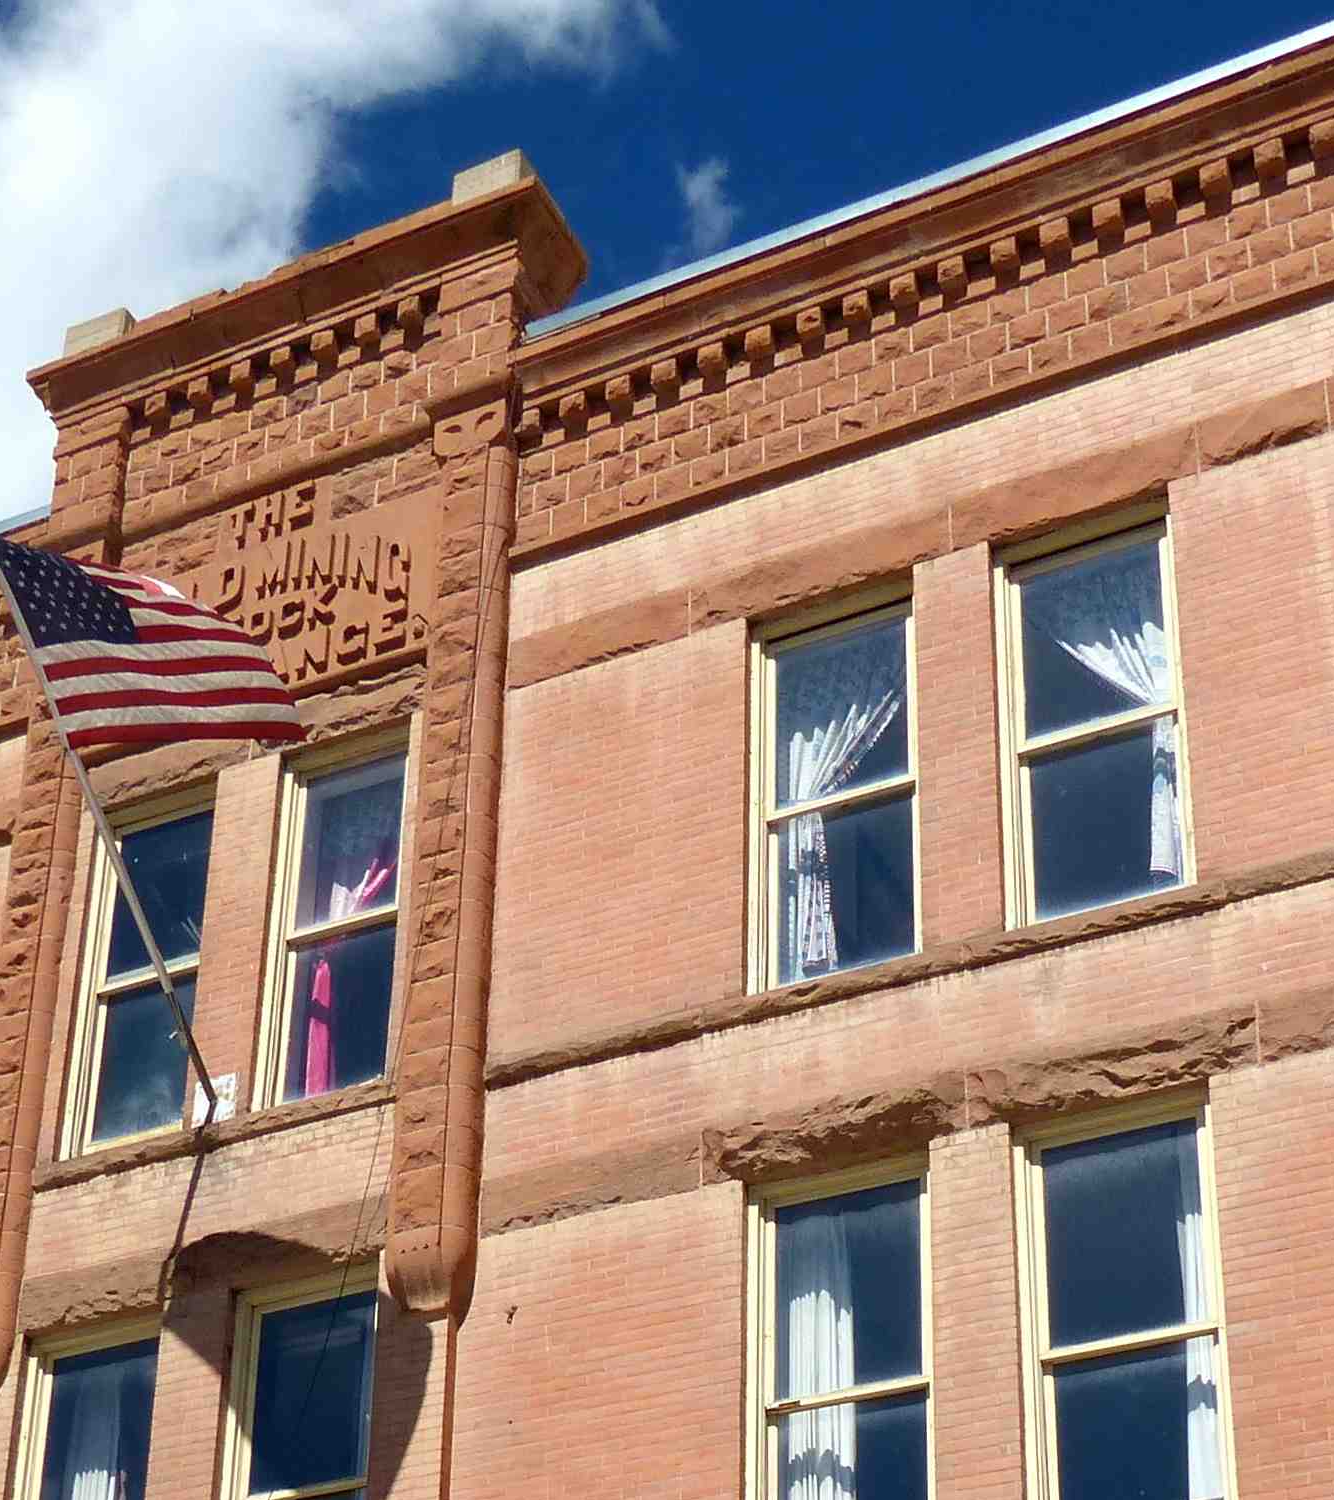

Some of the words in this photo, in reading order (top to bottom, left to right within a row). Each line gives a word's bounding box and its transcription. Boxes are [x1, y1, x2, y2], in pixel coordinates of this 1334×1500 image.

[230, 480, 317, 550] THE
[255, 533, 412, 601] MINING
[233, 584, 338, 647] OCK
